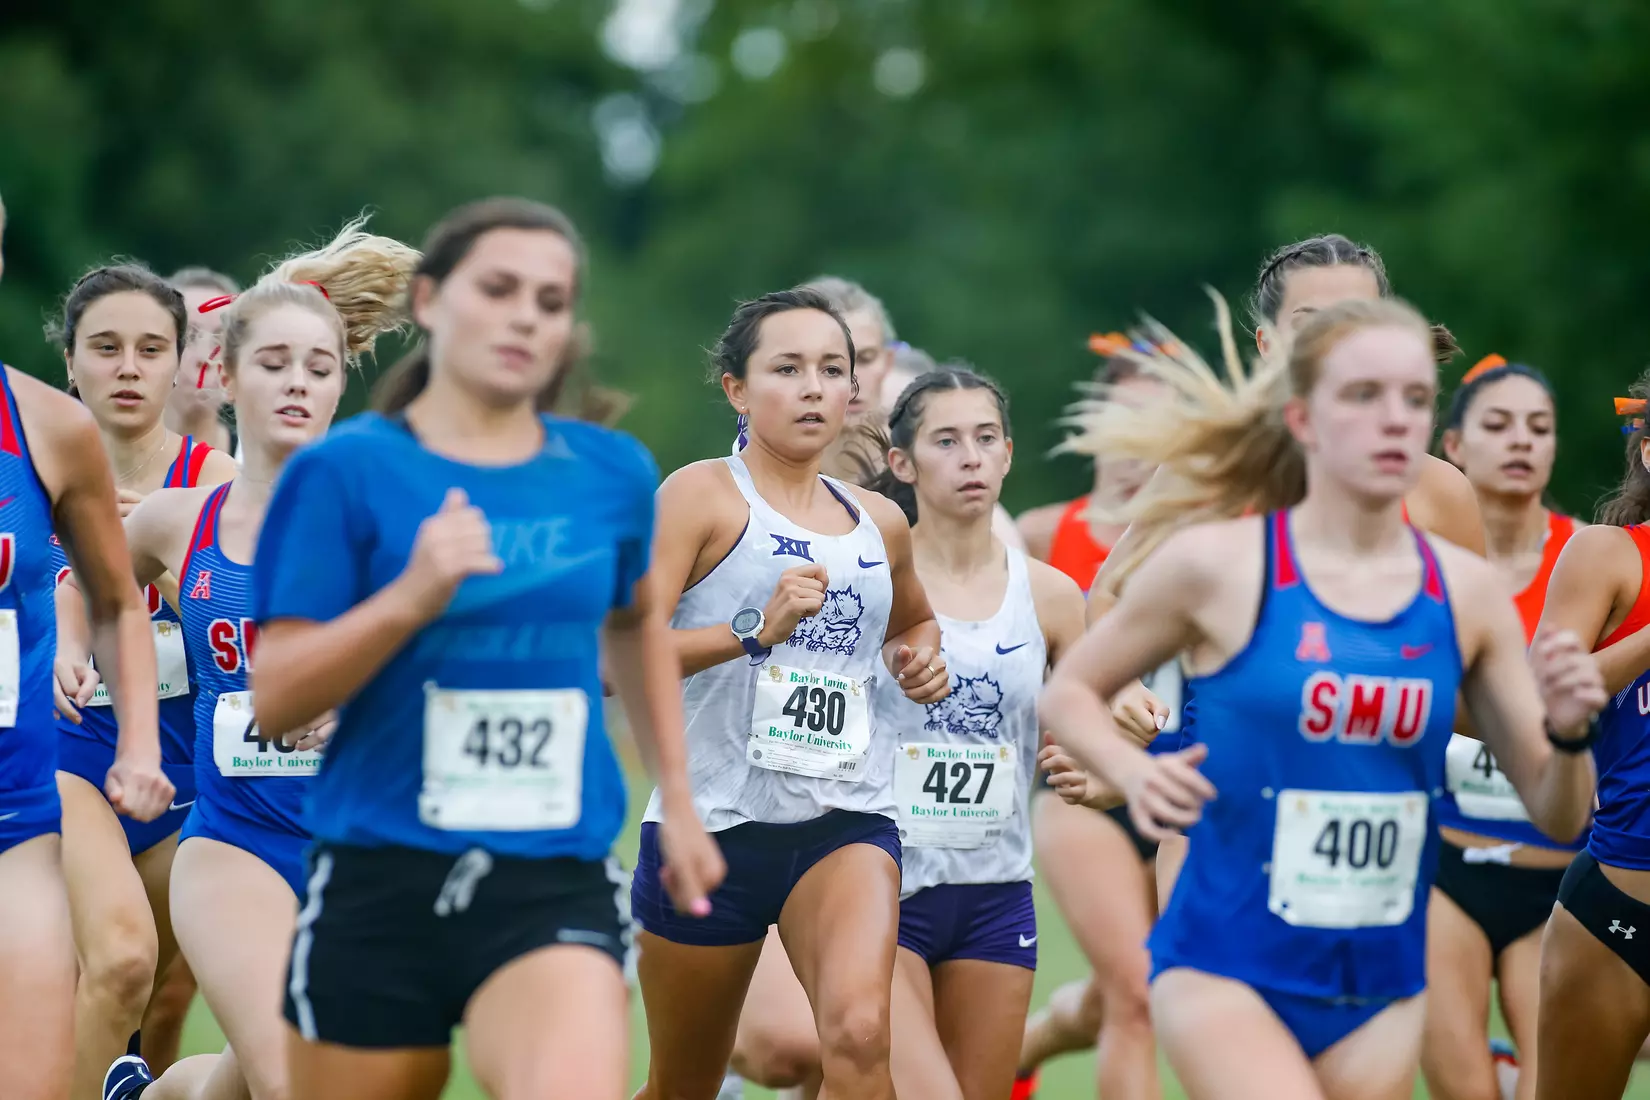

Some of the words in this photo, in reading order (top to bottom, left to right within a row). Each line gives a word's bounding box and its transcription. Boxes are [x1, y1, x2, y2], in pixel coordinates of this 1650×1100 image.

[769, 532, 815, 563] XII
[789, 671, 820, 685] Baylor
[823, 675, 848, 690] Invite
[782, 685, 846, 736] 430
[1298, 670, 1433, 747] SMU
[462, 716, 553, 769] 432
[768, 726, 804, 741] Baylor
[807, 733, 853, 752] University
[927, 747, 962, 760] Baylor
[966, 749, 995, 760] Invite
[232, 756, 273, 769] Baylor
[922, 761, 995, 804] 427
[911, 805, 949, 818] Baylor
[953, 807, 999, 818] University
[1313, 818, 1399, 869] 400
